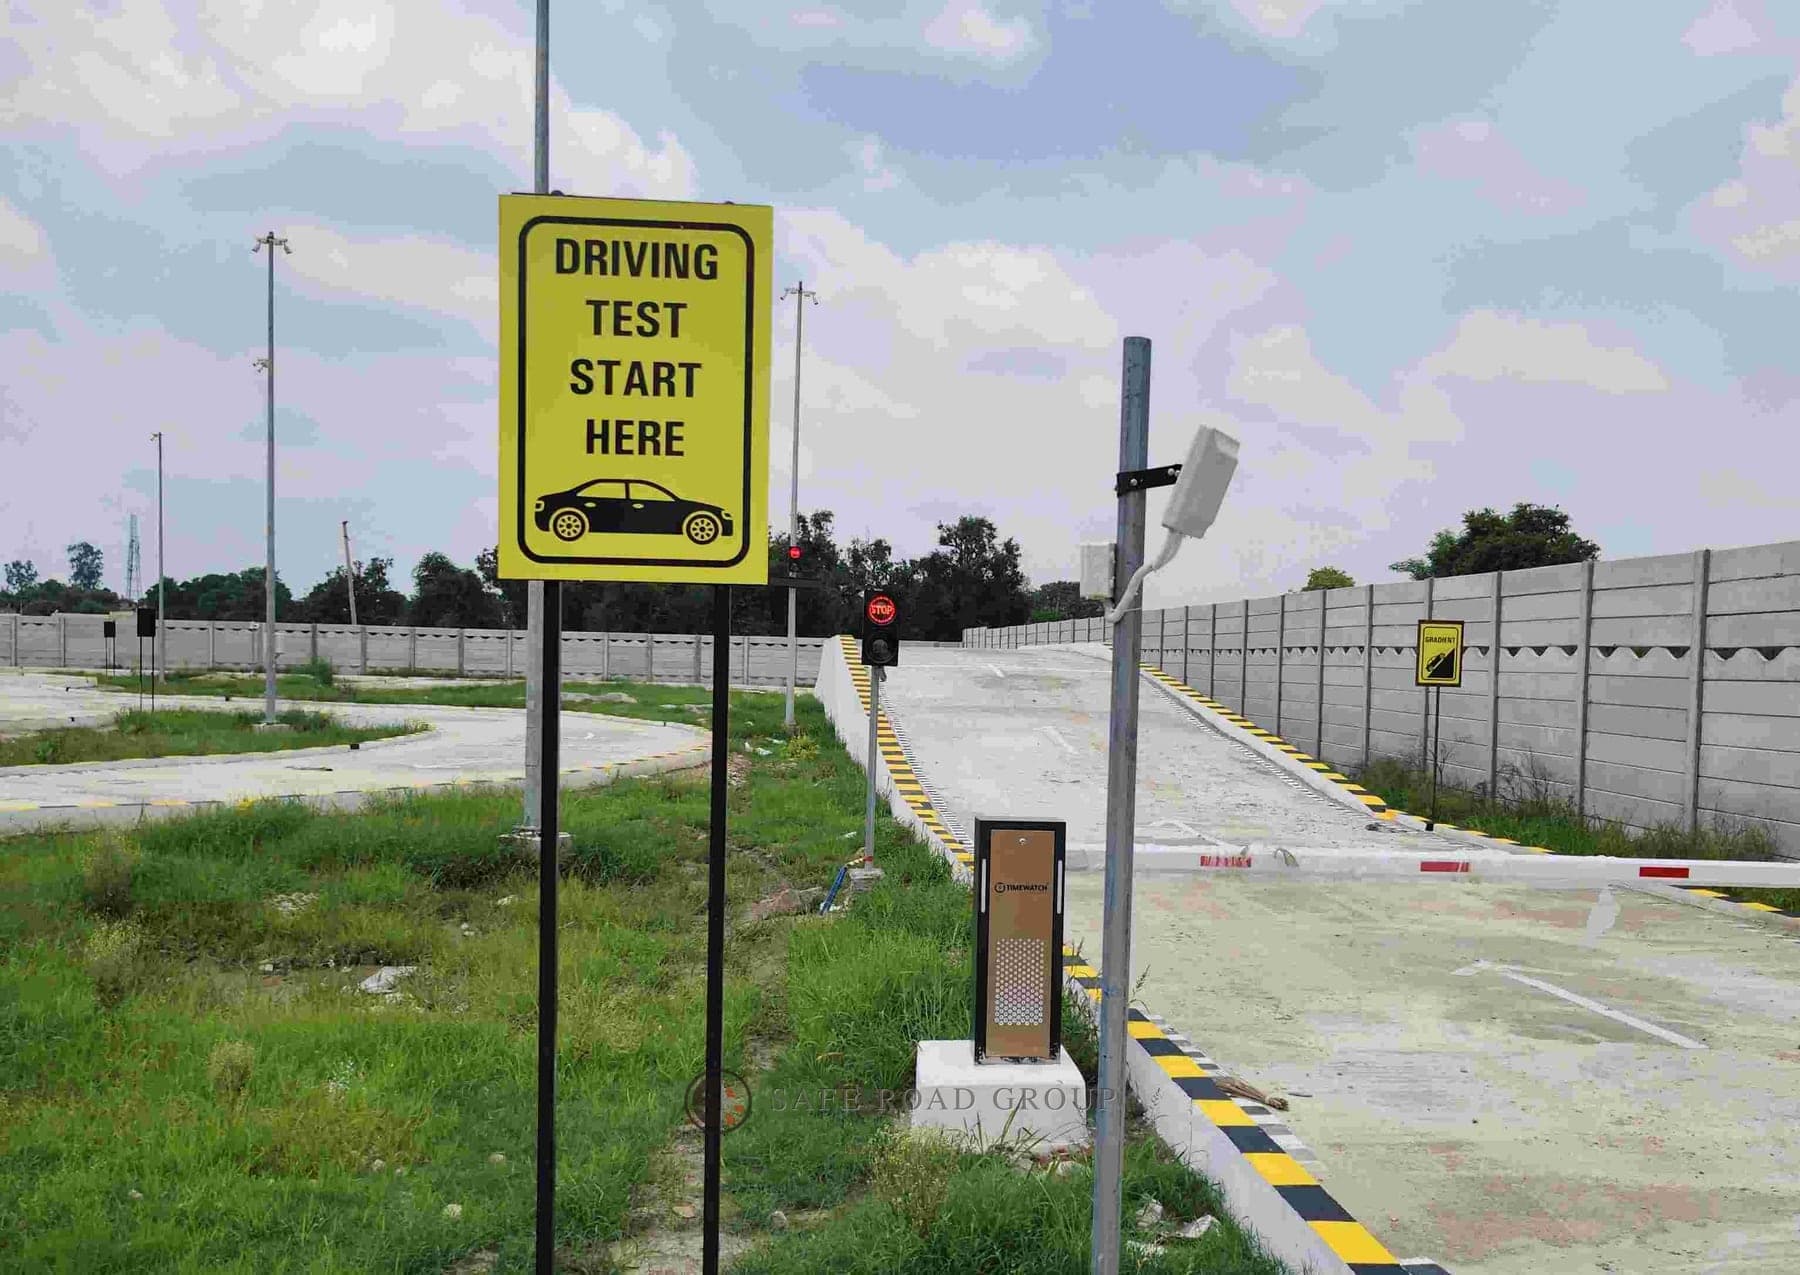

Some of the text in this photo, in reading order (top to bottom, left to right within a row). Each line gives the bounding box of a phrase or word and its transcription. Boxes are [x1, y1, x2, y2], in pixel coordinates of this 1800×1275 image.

[555, 237, 719, 281] DRIVING
[585, 299, 688, 338] TEST
[569, 358, 702, 398] START
[585, 418, 685, 457] HERE
[870, 604, 893, 615] STOP
[1006, 884, 1048, 892] TIMEWATCH
